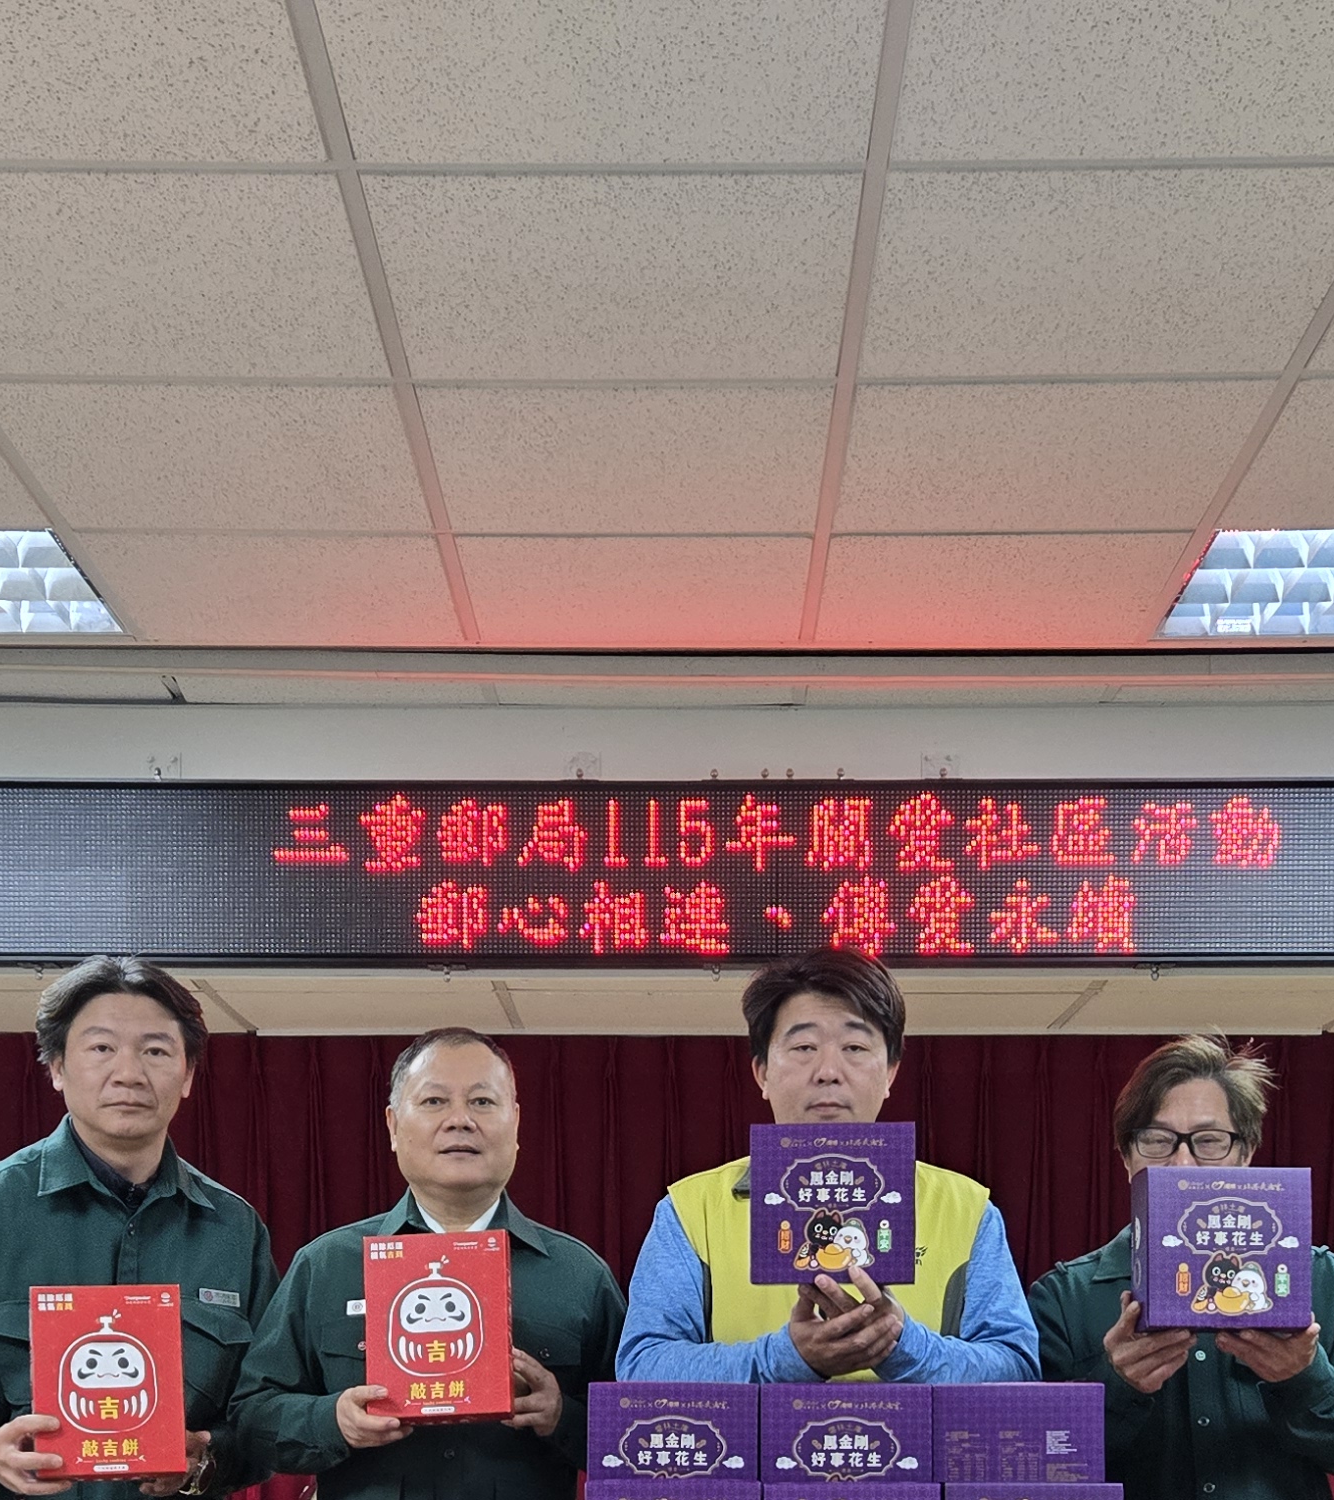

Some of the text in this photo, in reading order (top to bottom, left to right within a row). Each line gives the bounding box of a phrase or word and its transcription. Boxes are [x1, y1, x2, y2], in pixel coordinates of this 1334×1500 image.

[273, 794, 1283, 873] 三重郵局115年關愛社區活動
[809, 1170, 855, 1186] 黑金剛
[798, 1187, 867, 1203] 好事花生
[1207, 1214, 1252, 1230] 黑金剛
[1195, 1231, 1265, 1246] 好事花生
[425, 1339, 447, 1363] 吉
[410, 1380, 465, 1400] 敲吉餅
[97, 1396, 120, 1420] 吉
[81, 1438, 139, 1458] 敲吉餅
[637, 1450, 708, 1467] 好事花生
[811, 1452, 882, 1468] 好事花生
